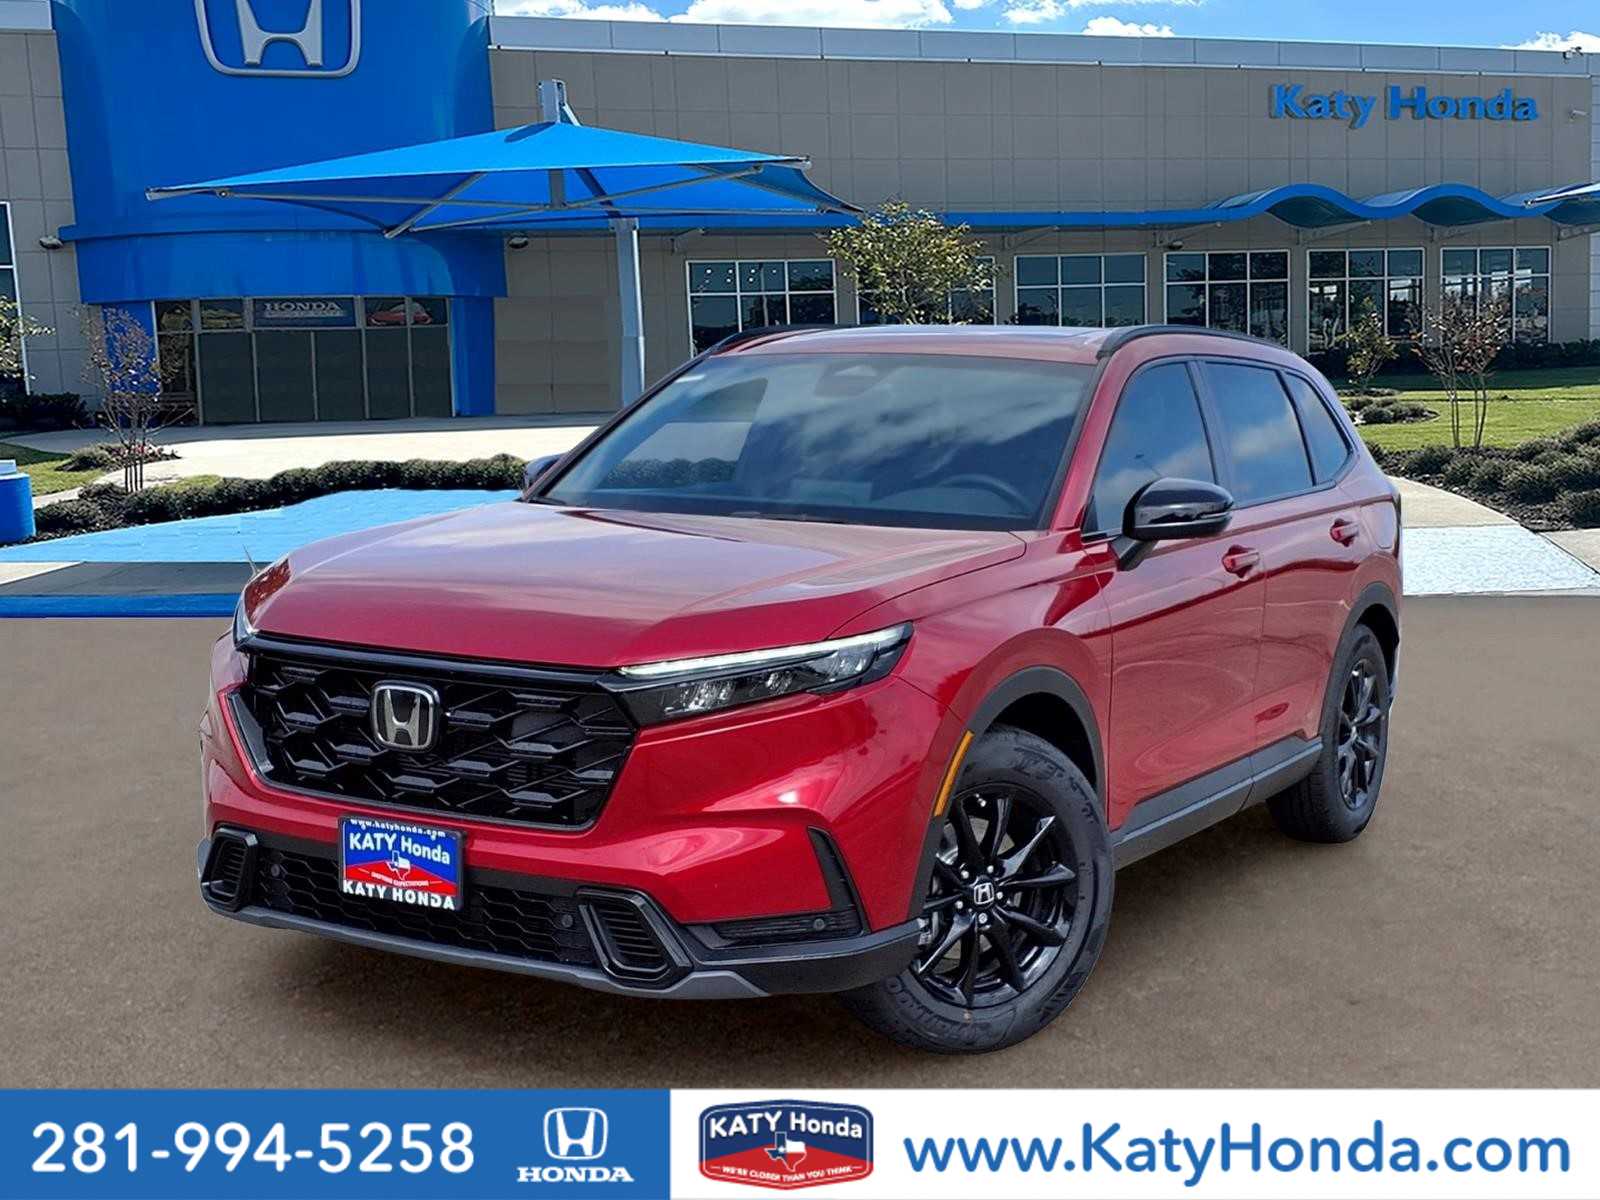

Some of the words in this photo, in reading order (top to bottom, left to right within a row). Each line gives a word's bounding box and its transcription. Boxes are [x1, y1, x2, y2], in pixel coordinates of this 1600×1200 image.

[1271, 84, 1376, 128] Katy
[1387, 84, 1539, 121] Honda
[264, 301, 343, 311] HONDA
[349, 832, 397, 851] KATY
[400, 835, 451, 865] Honda
[343, 880, 387, 899] KATY
[392, 887, 456, 910] HONDA
